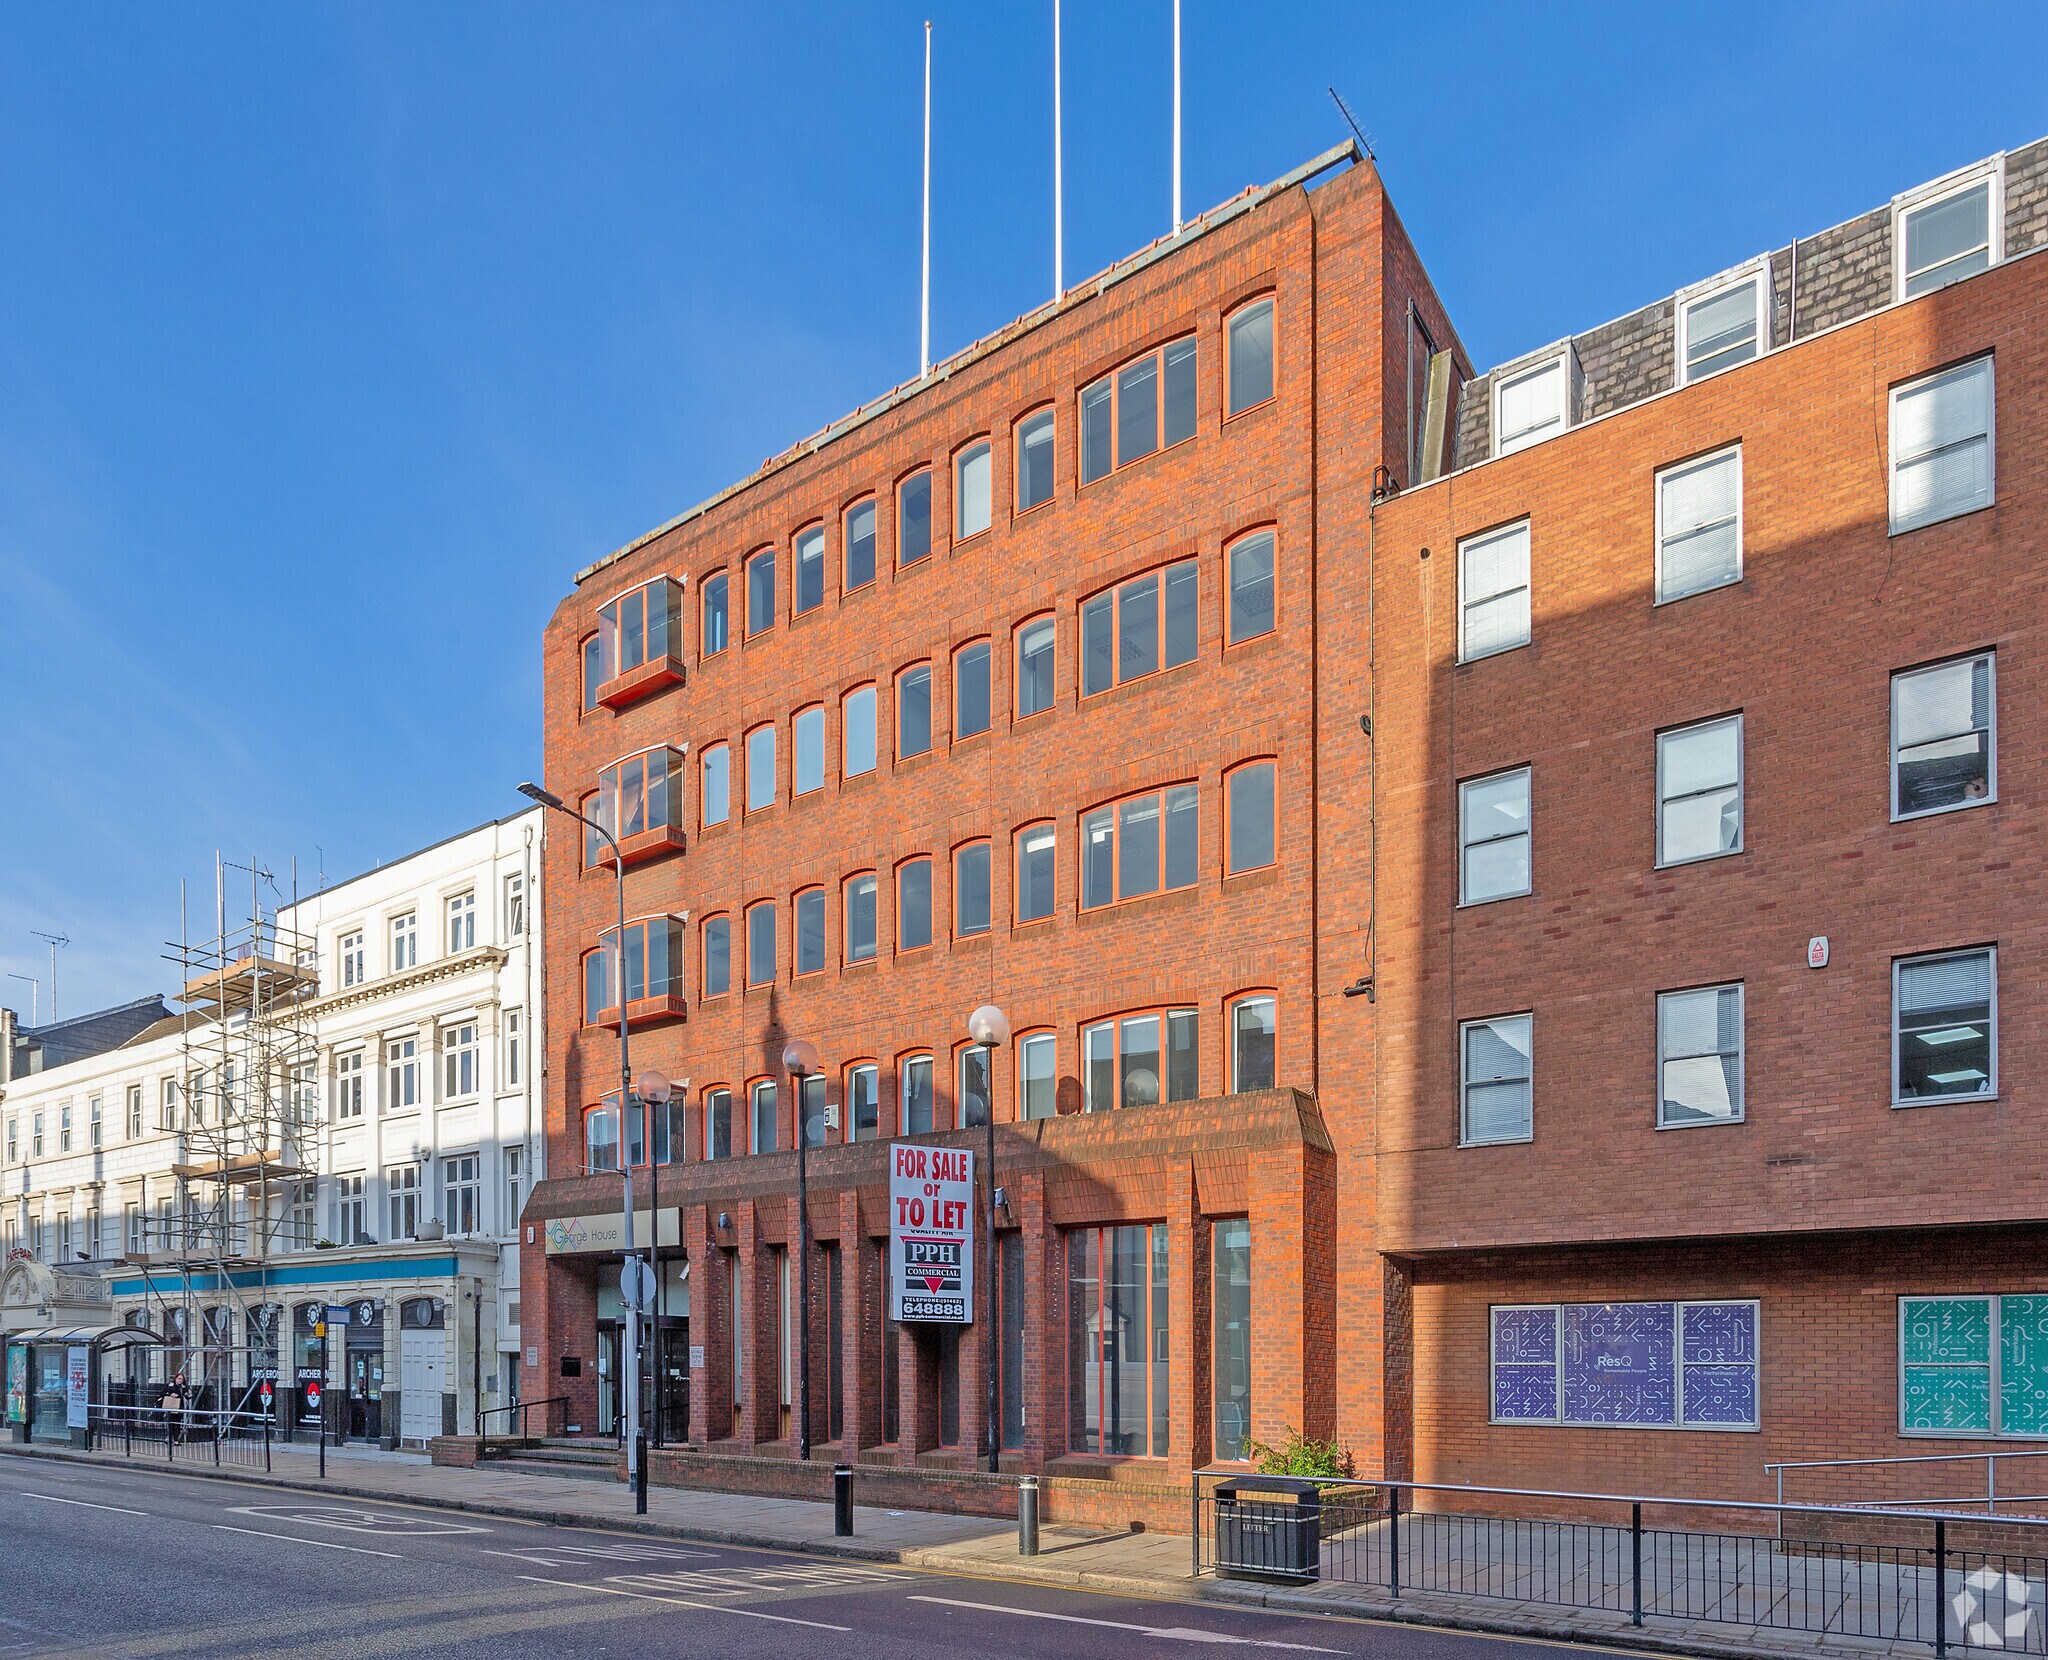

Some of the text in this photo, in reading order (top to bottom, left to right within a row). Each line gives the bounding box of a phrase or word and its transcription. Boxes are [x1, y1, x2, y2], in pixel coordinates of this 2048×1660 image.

[896, 1148, 967, 1182] FOR SALE
[923, 1183, 940, 1197] or
[896, 1197, 967, 1230] TO LET
[554, 1228, 618, 1245] George House
[910, 1243, 956, 1263] PPH
[907, 1267, 959, 1277] COMMERCIAL
[903, 1302, 964, 1316] 648888
[1597, 1355, 1632, 1367] ResQ
[1242, 1523, 1269, 1532] LITTER
[479, 1544, 722, 1567] ONLY
[602, 1563, 916, 1596] AHEAD
